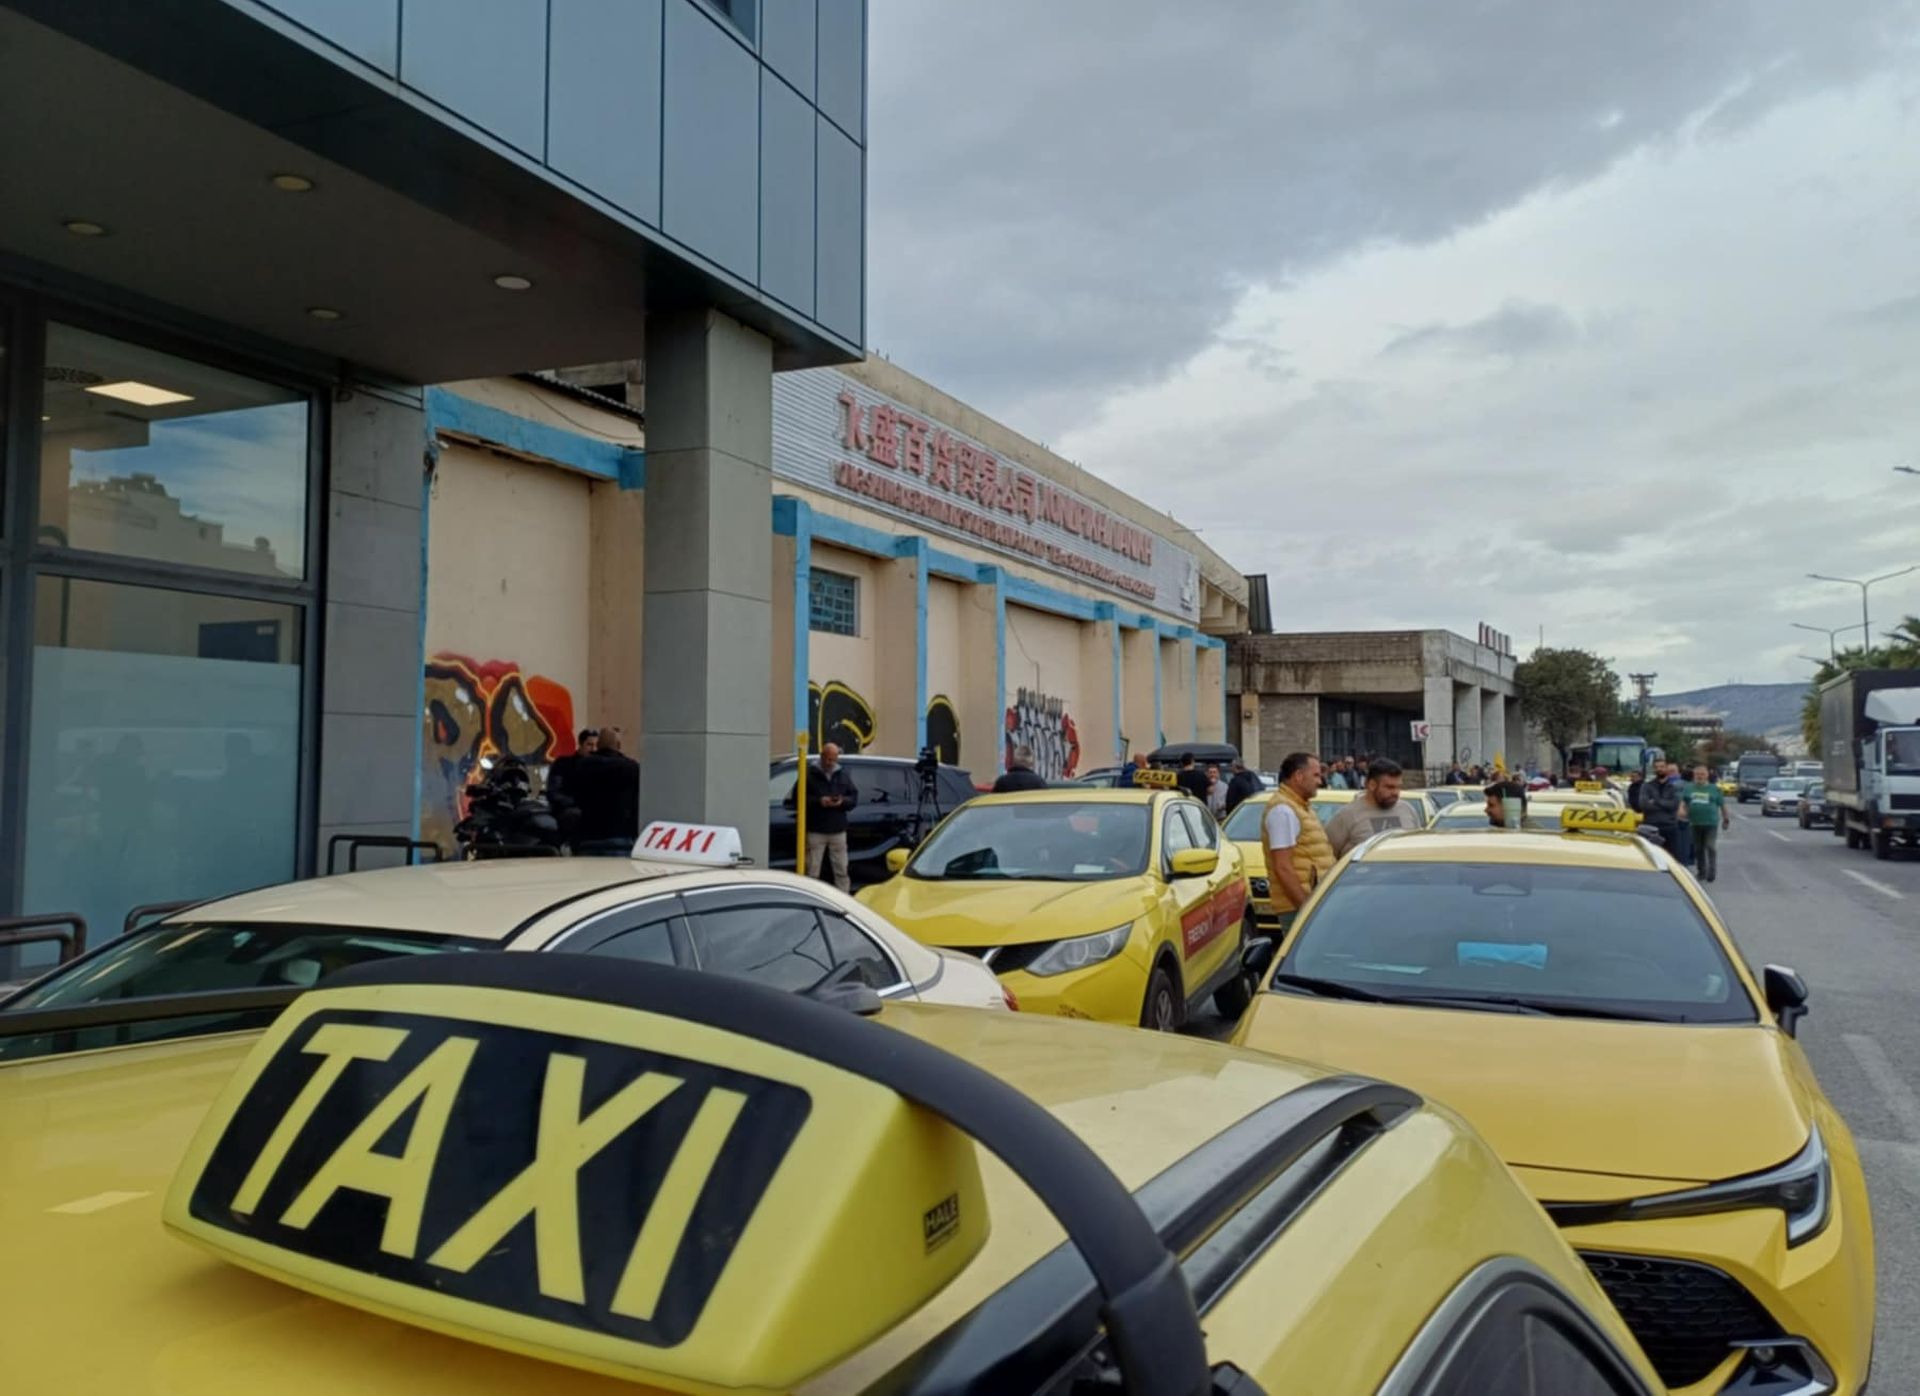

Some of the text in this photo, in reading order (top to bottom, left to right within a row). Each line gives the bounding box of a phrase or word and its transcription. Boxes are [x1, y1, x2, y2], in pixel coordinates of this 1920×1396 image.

[1567, 808, 1627, 823] TAXI
[644, 826, 716, 853] TAXI
[231, 1023, 748, 1322] TAXI
[926, 1197, 957, 1236] HALE
